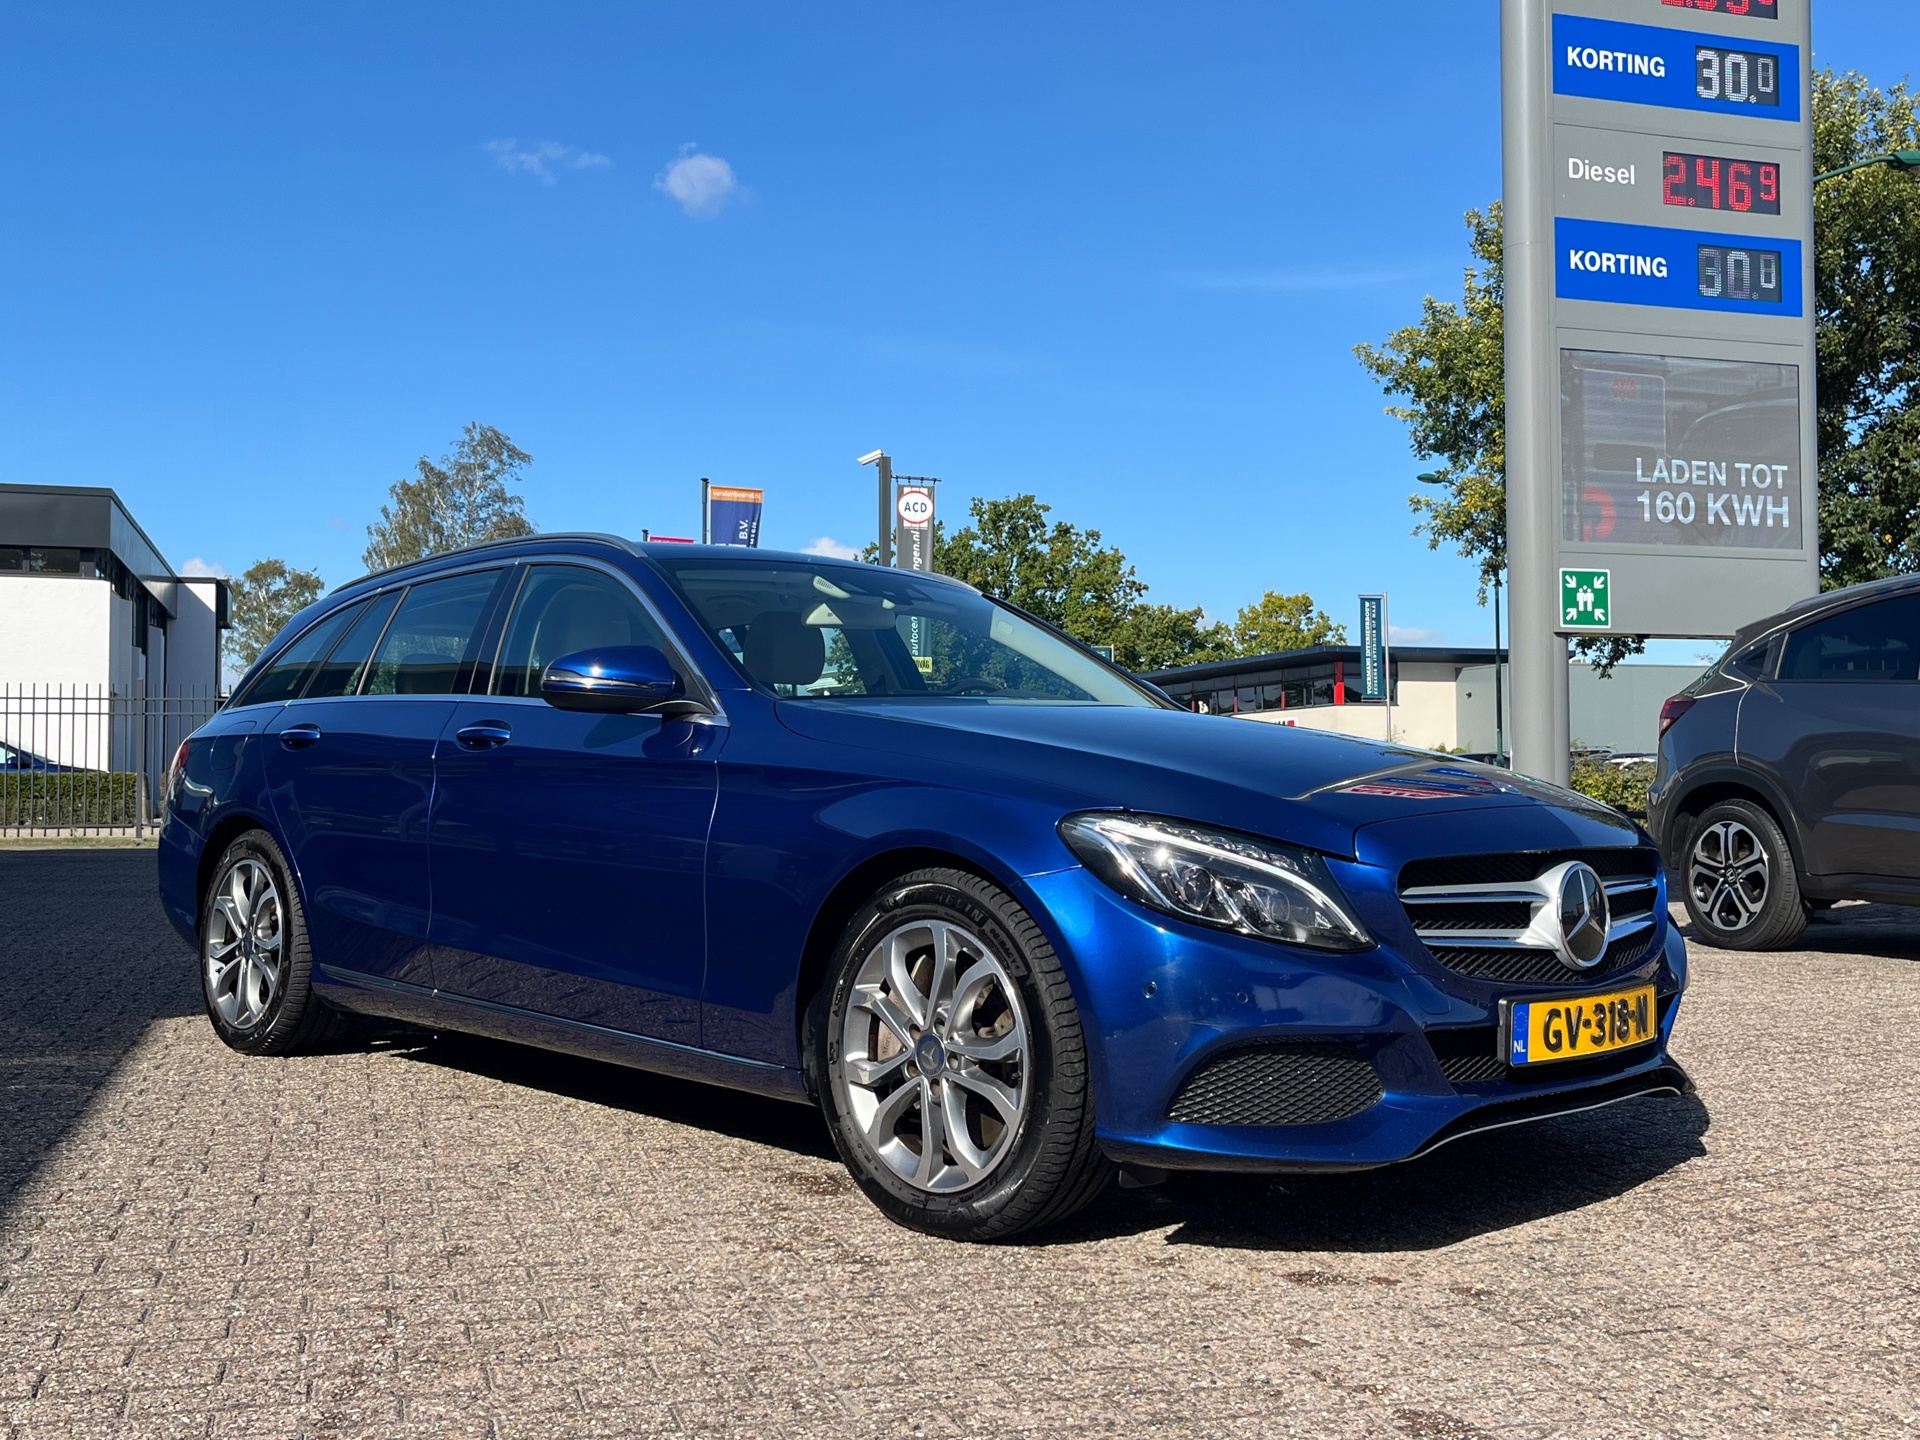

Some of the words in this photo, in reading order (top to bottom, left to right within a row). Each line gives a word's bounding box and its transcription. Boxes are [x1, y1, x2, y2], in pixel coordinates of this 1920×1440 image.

[1567, 46, 1666, 77] KORTING
[1568, 157, 1635, 185] Diesel
[1569, 250, 1668, 278] KORTING
[1636, 457, 1727, 487] LADEN
[1735, 462, 1788, 489] TOT
[904, 501, 927, 513] ACD
[1636, 490, 1696, 525] 160
[1707, 492, 1790, 528] KWH
[739, 519, 749, 539] B.V.
[1543, 993, 1649, 1053] GV-318-N
[1513, 1039, 1527, 1053] NL
